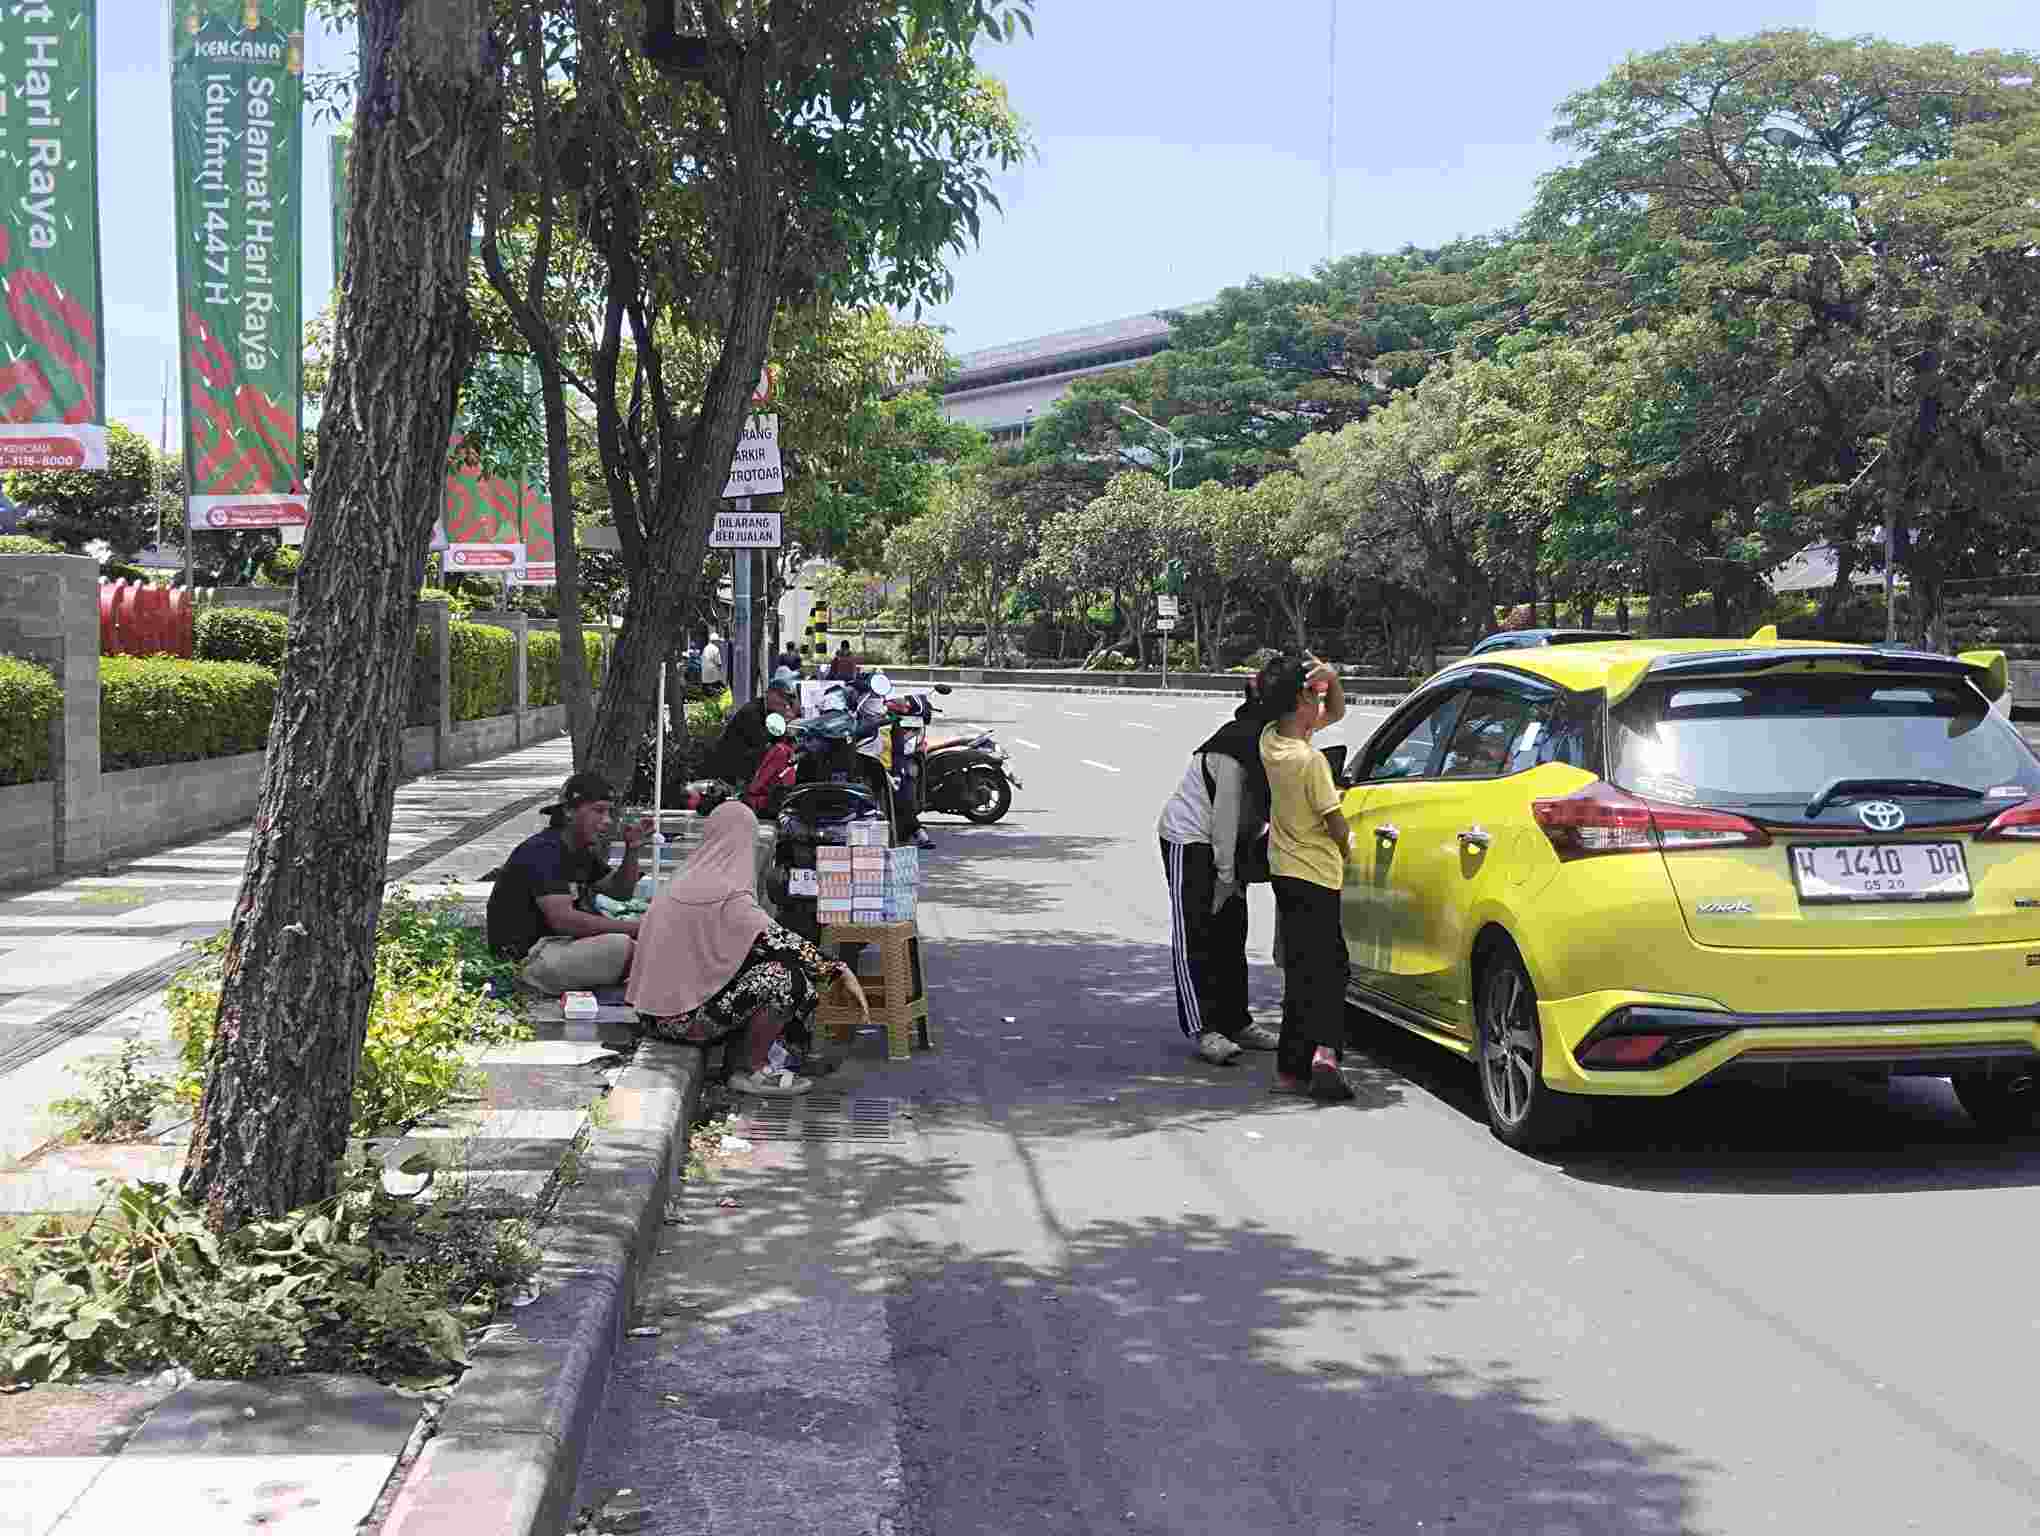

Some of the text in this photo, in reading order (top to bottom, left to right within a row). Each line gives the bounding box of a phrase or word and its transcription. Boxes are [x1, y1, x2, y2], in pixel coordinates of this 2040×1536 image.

[194, 40, 280, 58] KENCANA
[24, 35, 62, 127] Hari
[20, 138, 61, 248] Raya
[203, 74, 231, 305] Idulfitri 1447 H
[239, 75, 275, 370] Selamat Hari Raya
[742, 428, 773, 440] RANG
[736, 448, 765, 461] ARKIR
[730, 466, 780, 482] TROTOAR
[720, 518, 769, 528] DILARANG
[1836, 848, 1903, 876] 1410
[1926, 848, 1962, 875] DH
